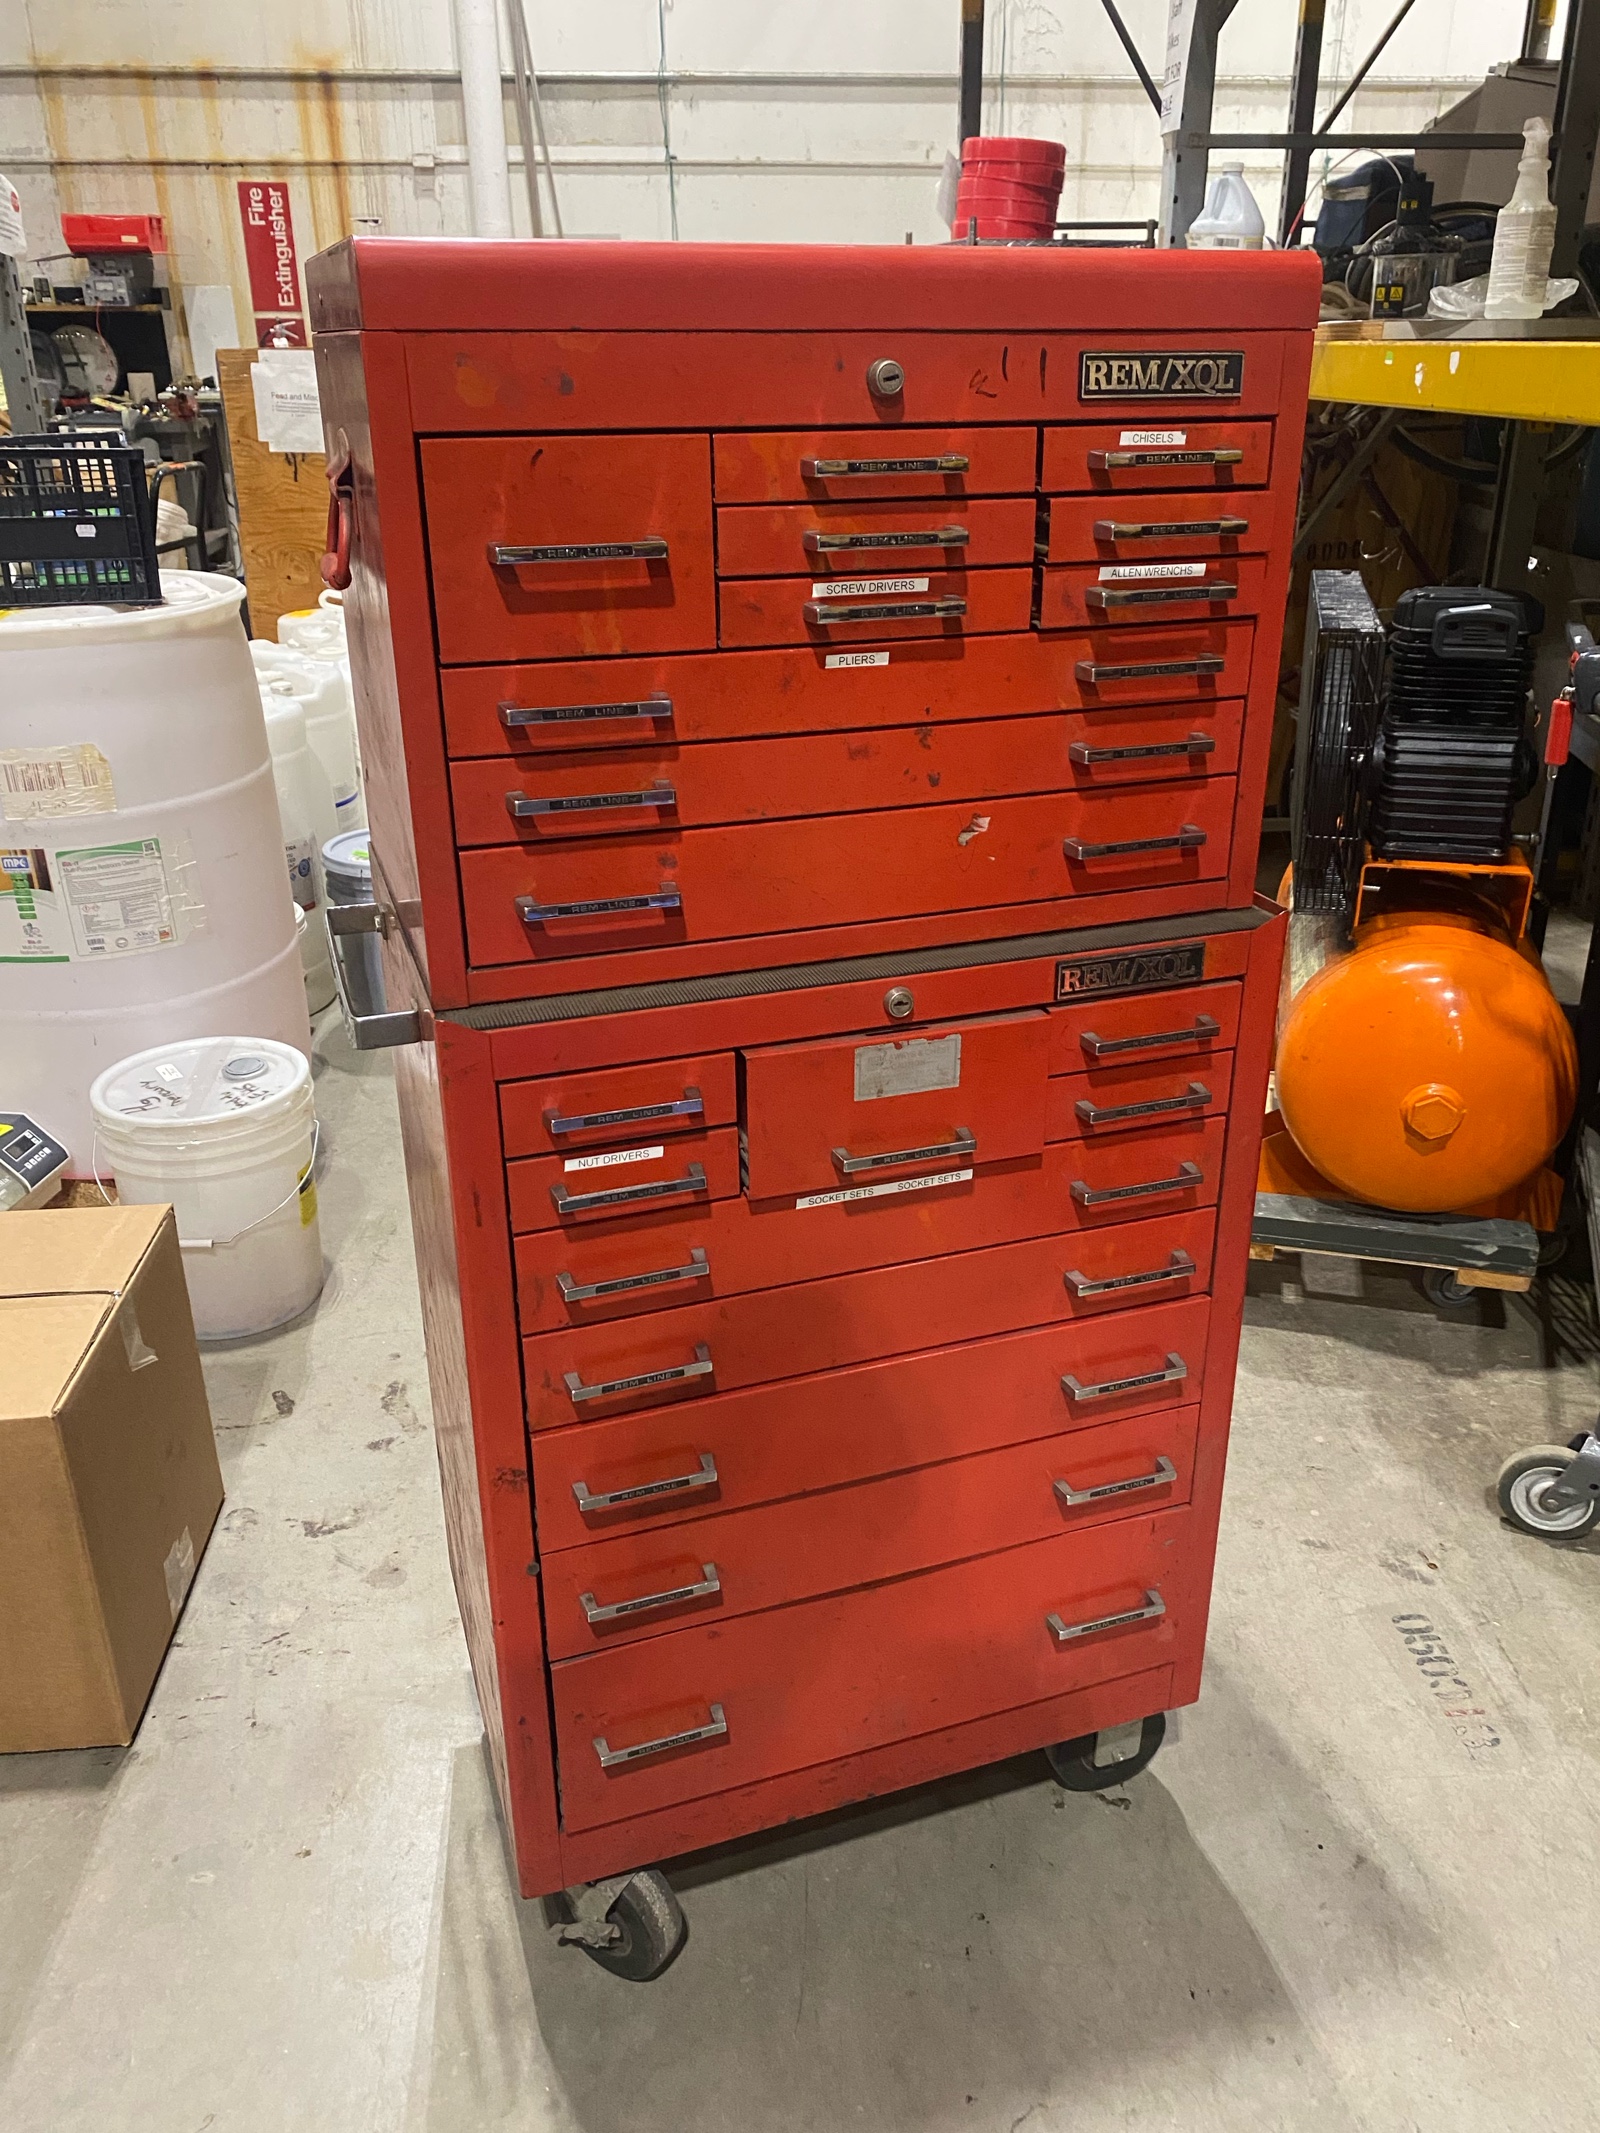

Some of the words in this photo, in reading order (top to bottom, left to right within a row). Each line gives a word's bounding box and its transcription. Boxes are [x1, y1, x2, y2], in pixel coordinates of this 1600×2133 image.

[248, 187, 266, 225] Fire
[268, 187, 295, 307] Extinguisher
[1086, 358, 1234, 395] REM/XQL
[1132, 433, 1174, 444] CHISELS
[860, 464, 888, 472] REM
[896, 462, 926, 470] LINE
[547, 549, 578, 558] REM
[587, 548, 620, 556] LINE
[1111, 567, 1142, 578] ALLEN
[1145, 565, 1193, 576] WRENCHS
[826, 583, 866, 594] SCREW
[869, 581, 915, 592] DRIVERS
[839, 655, 876, 666] PLIERS
[556, 710, 586, 718] REM
[594, 706, 624, 716] LINE
[562, 800, 592, 808] REM
[600, 797, 630, 805] LINE
[571, 904, 599, 912] REM
[607, 900, 636, 910] LINE
[1061, 952, 1196, 994] REM/XQL
[597, 1114, 624, 1123] REM
[632, 1108, 659, 1118] LINE
[578, 1157, 601, 1168] NUT
[603, 1149, 650, 1164] DRIVERS
[808, 1192, 846, 1206] SOCKET
[849, 1187, 874, 1199] SETS
[897, 1177, 935, 1191] SOCKET
[937, 1172, 961, 1184] SETS
